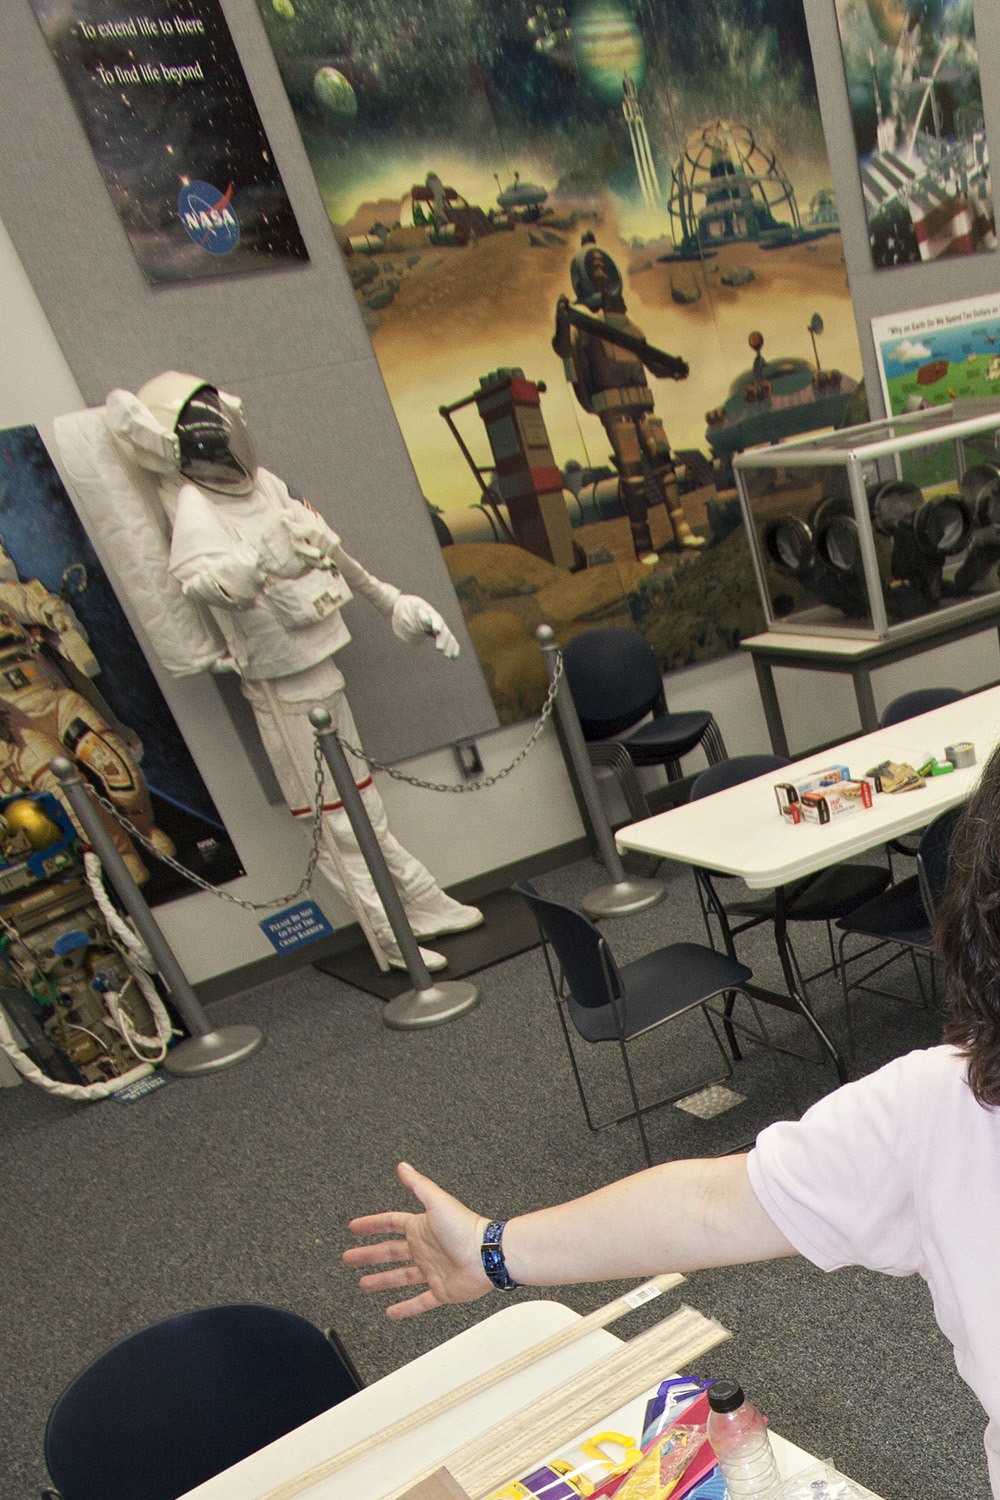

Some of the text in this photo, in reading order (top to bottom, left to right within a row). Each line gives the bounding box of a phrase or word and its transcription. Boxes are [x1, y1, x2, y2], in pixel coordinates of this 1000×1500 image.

[78, 20, 97, 39] To
[98, 16, 138, 38] extend
[136, 15, 159, 37] life
[158, 17, 174, 36] to
[173, 14, 205, 36] there
[96, 66, 115, 86] To
[113, 64, 141, 85] find
[139, 63, 161, 84] life
[159, 60, 204, 87] beyond
[184, 208, 236, 232] NASA
[912, 320, 926, 330] Earth
[936, 317, 945, 326] We
[945, 313, 962, 325] Spend
[973, 307, 992, 318] Dollars
